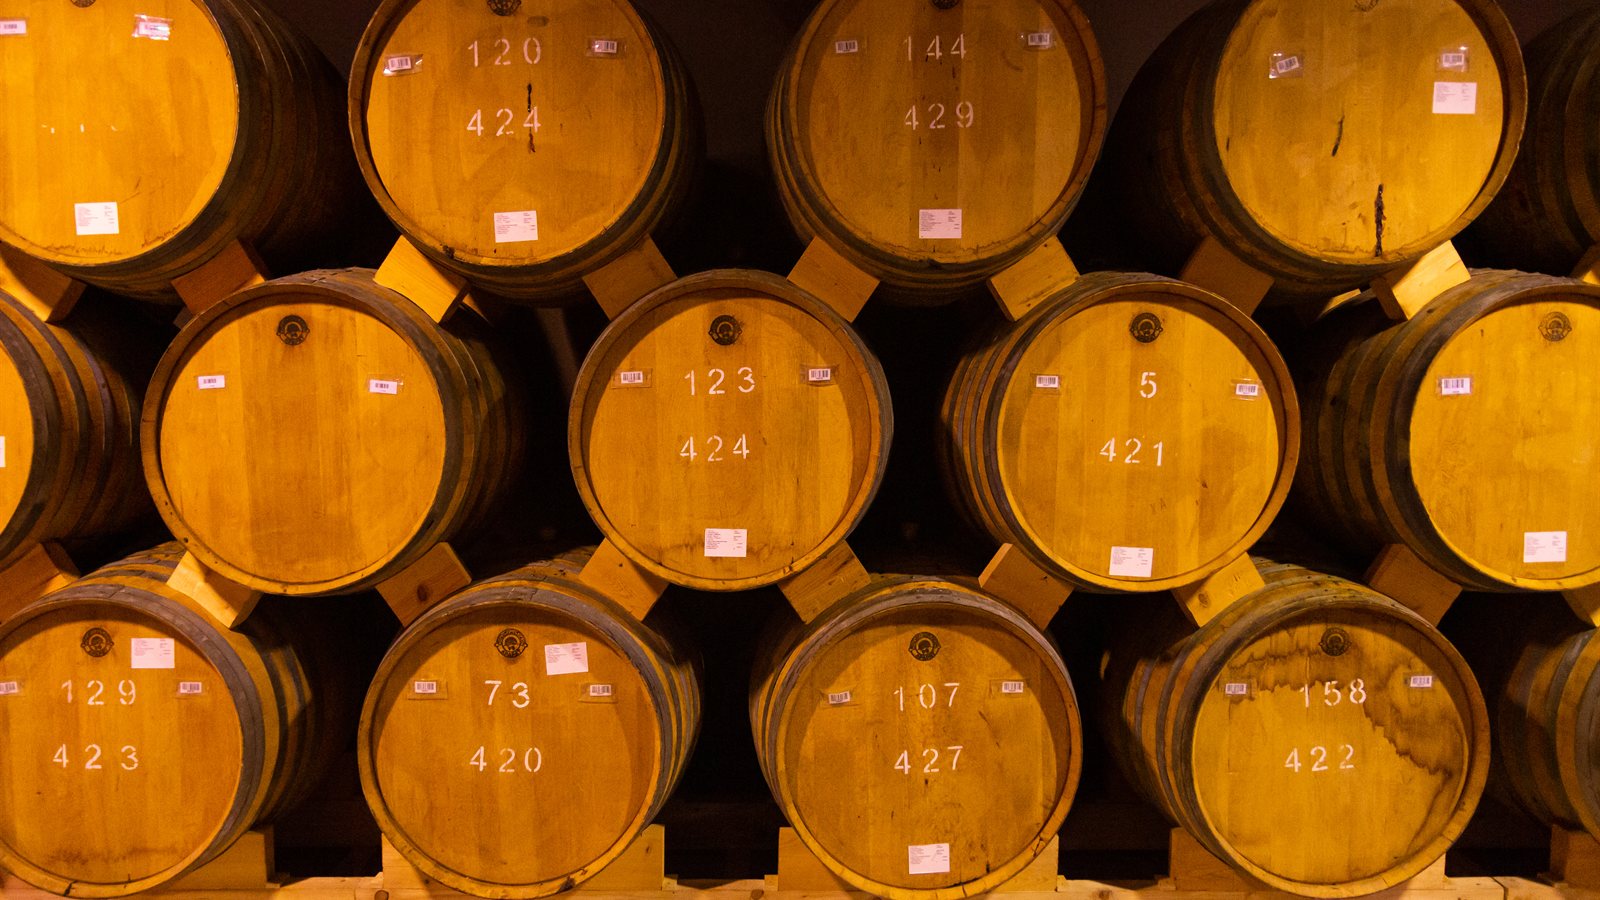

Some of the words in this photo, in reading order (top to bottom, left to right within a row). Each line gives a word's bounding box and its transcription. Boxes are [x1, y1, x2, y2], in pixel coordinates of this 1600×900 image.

[468, 37, 542, 68] 120
[904, 33, 967, 61] 144
[466, 106, 541, 137] 424
[904, 101, 975, 130] 429
[684, 366, 756, 396] 123
[1139, 371, 1157, 399] 5
[680, 433, 750, 462] 424
[1099, 437, 1164, 467] 421
[61, 679, 137, 706] 129
[484, 679, 530, 709] 73
[893, 682, 960, 711] 107
[1300, 678, 1367, 708] 158
[53, 743, 139, 771] 423
[469, 746, 542, 773] 420
[893, 745, 964, 775] 427
[1284, 744, 1355, 773] 422
